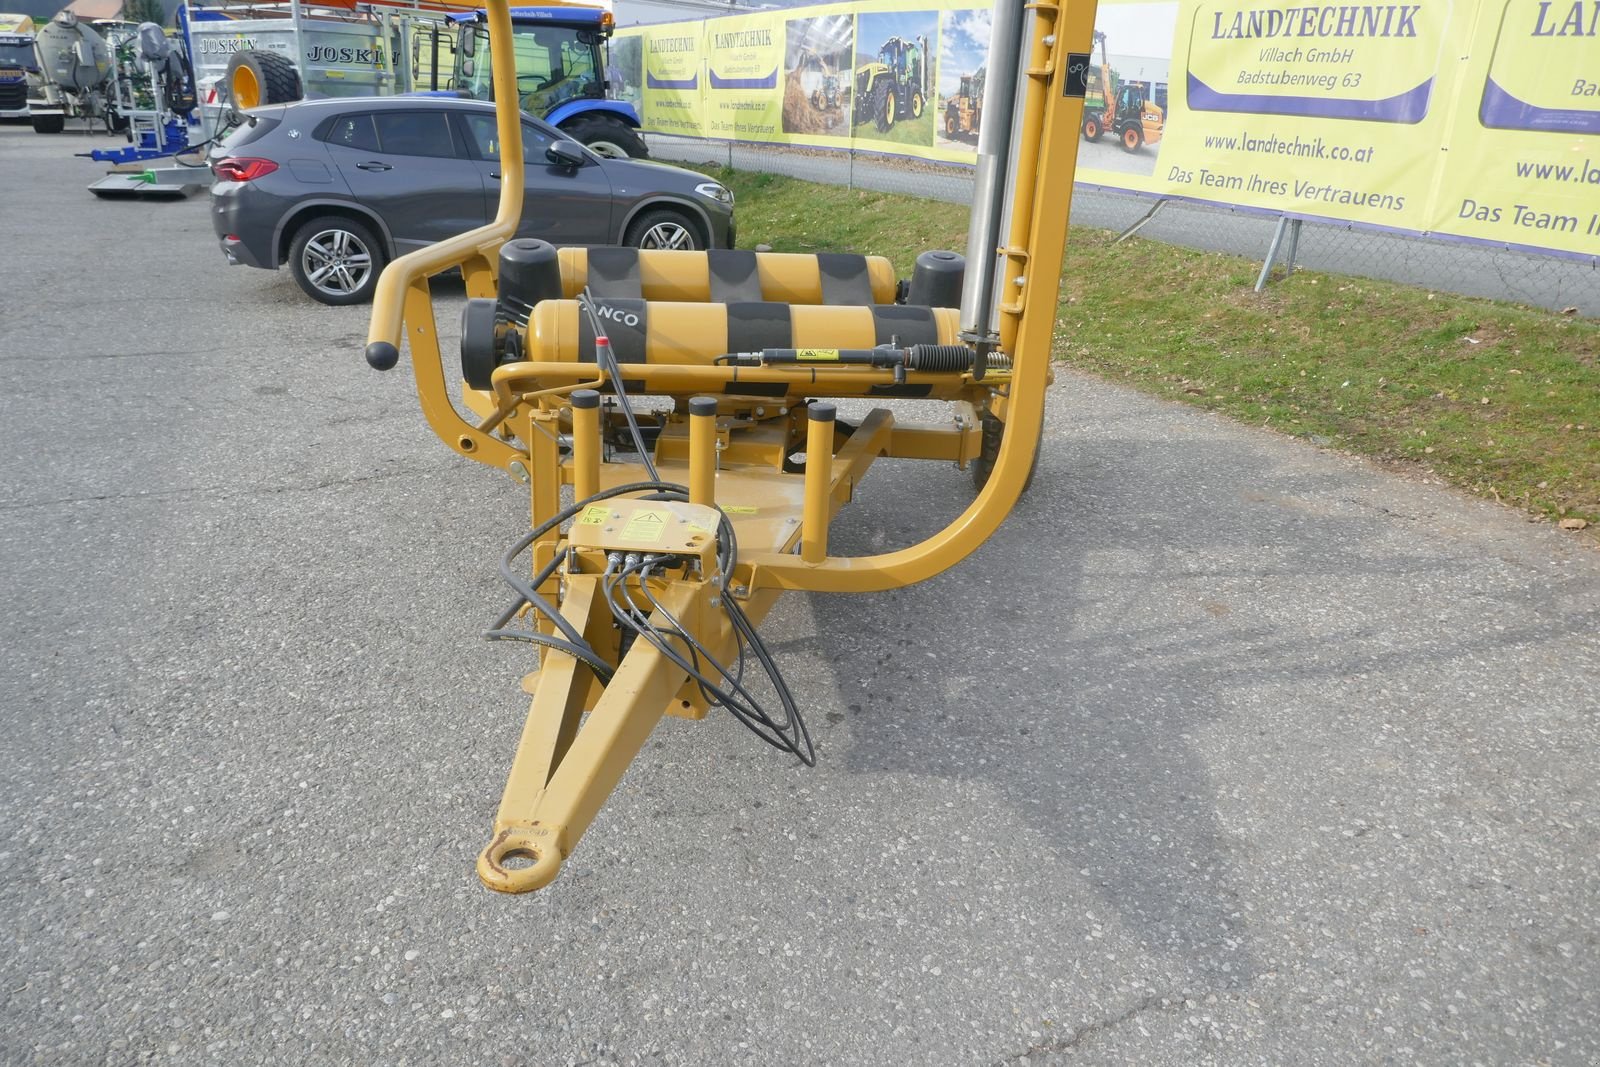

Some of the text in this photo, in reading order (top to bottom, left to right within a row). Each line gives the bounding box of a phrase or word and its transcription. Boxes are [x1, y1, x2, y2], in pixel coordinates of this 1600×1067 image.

[1211, 4, 1420, 39] LANDTECHNIK
[200, 38, 257, 54] JOSKIN
[650, 37, 695, 53] LANDTECHNIK
[715, 29, 772, 48] LANDTECHNIK
[1257, 47, 1354, 63] Villach GmbH
[1236, 69, 1362, 91] Badstubenweg 63
[1142, 113, 1159, 122] JCB
[1204, 131, 1374, 163] www.landtechnik.co.at
[1168, 165, 1406, 212] Das Team Ihres Vertrauens
[1458, 198, 1503, 223] Das
[1512, 204, 1579, 233] Team
